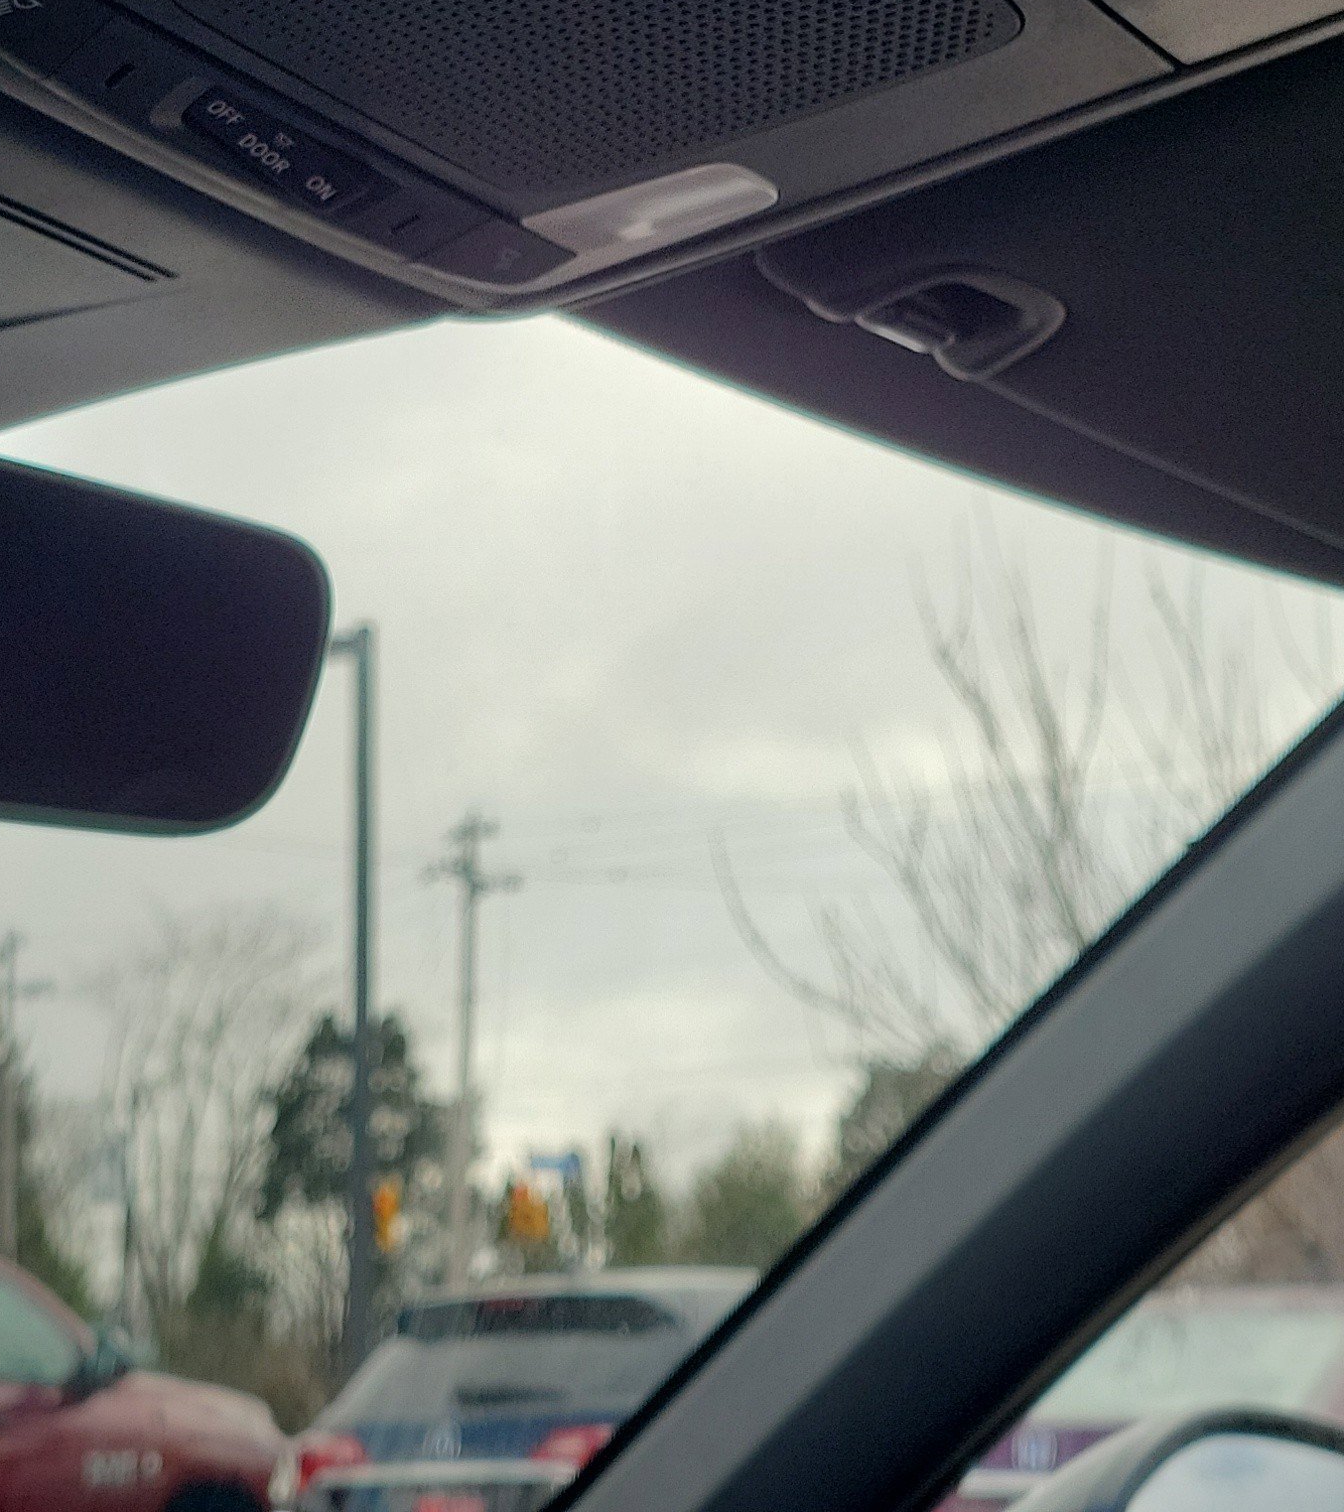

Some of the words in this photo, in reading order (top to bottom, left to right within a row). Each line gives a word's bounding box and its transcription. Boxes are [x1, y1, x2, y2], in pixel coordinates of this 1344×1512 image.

[207, 100, 244, 125] OFF
[238, 133, 290, 174] DOOR
[306, 175, 336, 201] ON
